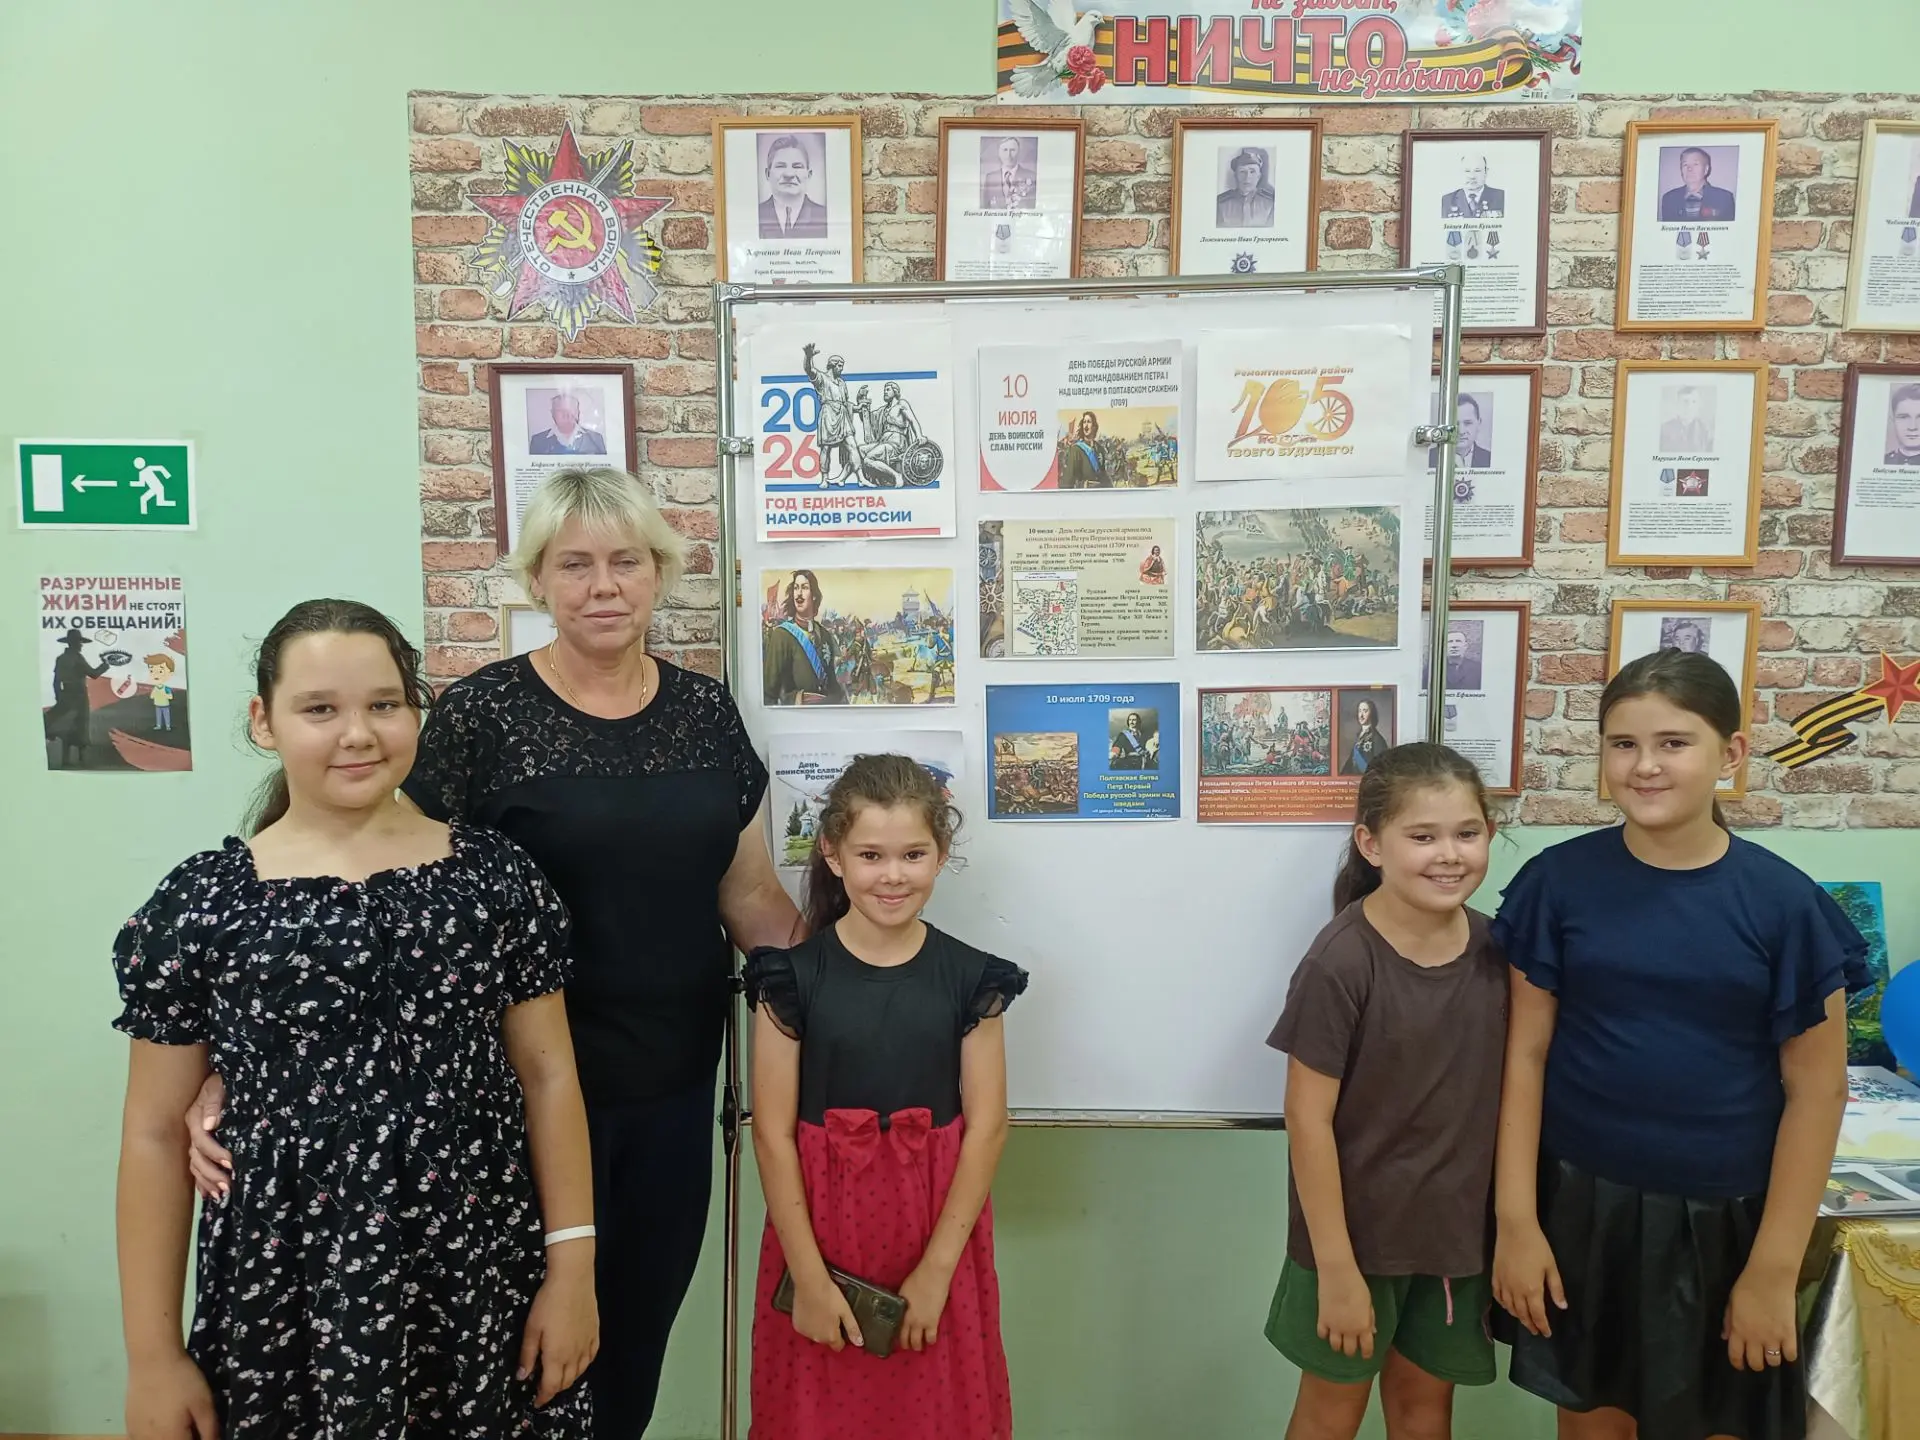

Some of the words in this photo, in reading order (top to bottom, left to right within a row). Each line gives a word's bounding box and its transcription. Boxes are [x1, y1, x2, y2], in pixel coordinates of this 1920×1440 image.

[1113, 15, 1407, 87] НИЧТО
[1319, 69, 1355, 92] не
[521, 184, 608, 273] ОТЕЧЕСТВЕННАЯ
[1068, 360, 1086, 370] ДЕНЬ
[1087, 359, 1116, 369] ПОБЕДЫ
[1117, 356, 1146, 368] РУССКОЙ
[1148, 357, 1172, 366] АРМИИ
[1068, 374, 1083, 384] ПОД
[1084, 372, 1143, 383] КОМАНДОВАНИЕМ
[1144, 371, 1165, 381] ПЕТРА
[1003, 374, 1028, 399] 10
[1071, 387, 1102, 396] ШВЕДАМИ
[1108, 385, 1147, 395] ПОЛТАВСКОМ
[761, 387, 820, 433] 20
[998, 411, 1037, 427] ИЮЛЯ
[988, 431, 1006, 441] ДЕНЬ
[1008, 429, 1044, 440] ВОИНСКОЙ
[990, 442, 1015, 452] СЛАВЫ
[1016, 441, 1043, 451] РОССИИ
[1227, 447, 1275, 458] ТВОЕГО
[1278, 446, 1354, 458] БУДУЩЕГО!
[762, 435, 821, 479] 26
[765, 497, 797, 511] ГОД
[802, 496, 886, 511] ЕДИНСТВА
[766, 512, 842, 526] НАРОДОВ
[847, 511, 912, 524] РОССИИ
[40, 577, 181, 592] РАЗРУШЕННЫЕ
[42, 594, 127, 611] ЖИЗНИ
[129, 602, 144, 611] НЕ
[146, 602, 181, 611] СТОЯТ
[42, 616, 66, 630] ИХ
[71, 613, 182, 631] ОБЕЩАНИЙ!
[1046, 695, 1057, 703] 10
[1060, 695, 1085, 703] июля
[1087, 694, 1111, 703] 1709
[1113, 695, 1134, 704] года
